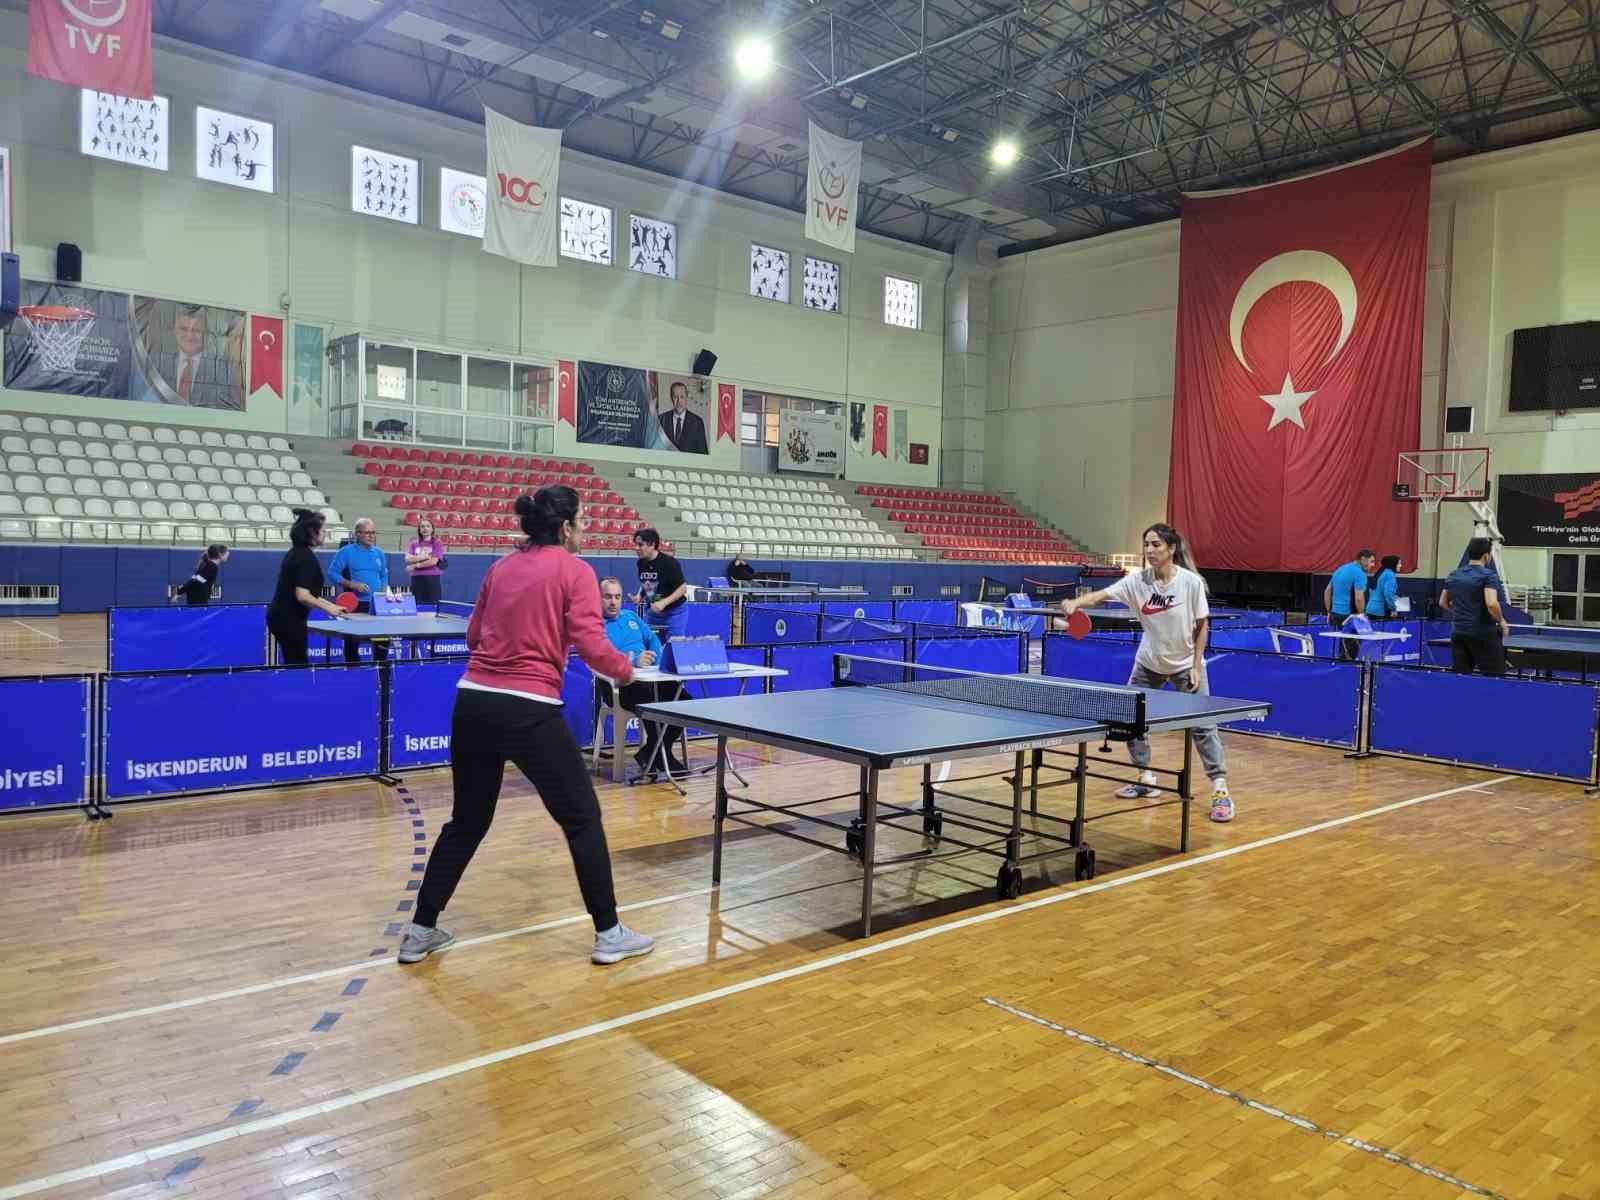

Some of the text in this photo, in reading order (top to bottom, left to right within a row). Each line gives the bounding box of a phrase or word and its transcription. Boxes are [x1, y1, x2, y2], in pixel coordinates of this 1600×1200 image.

[64, 23, 121, 57] TVF
[813, 198, 849, 226] TVF
[1148, 593, 1175, 608] NIKE
[127, 741, 362, 780] İSKENDERUN BELEDİYESİ
